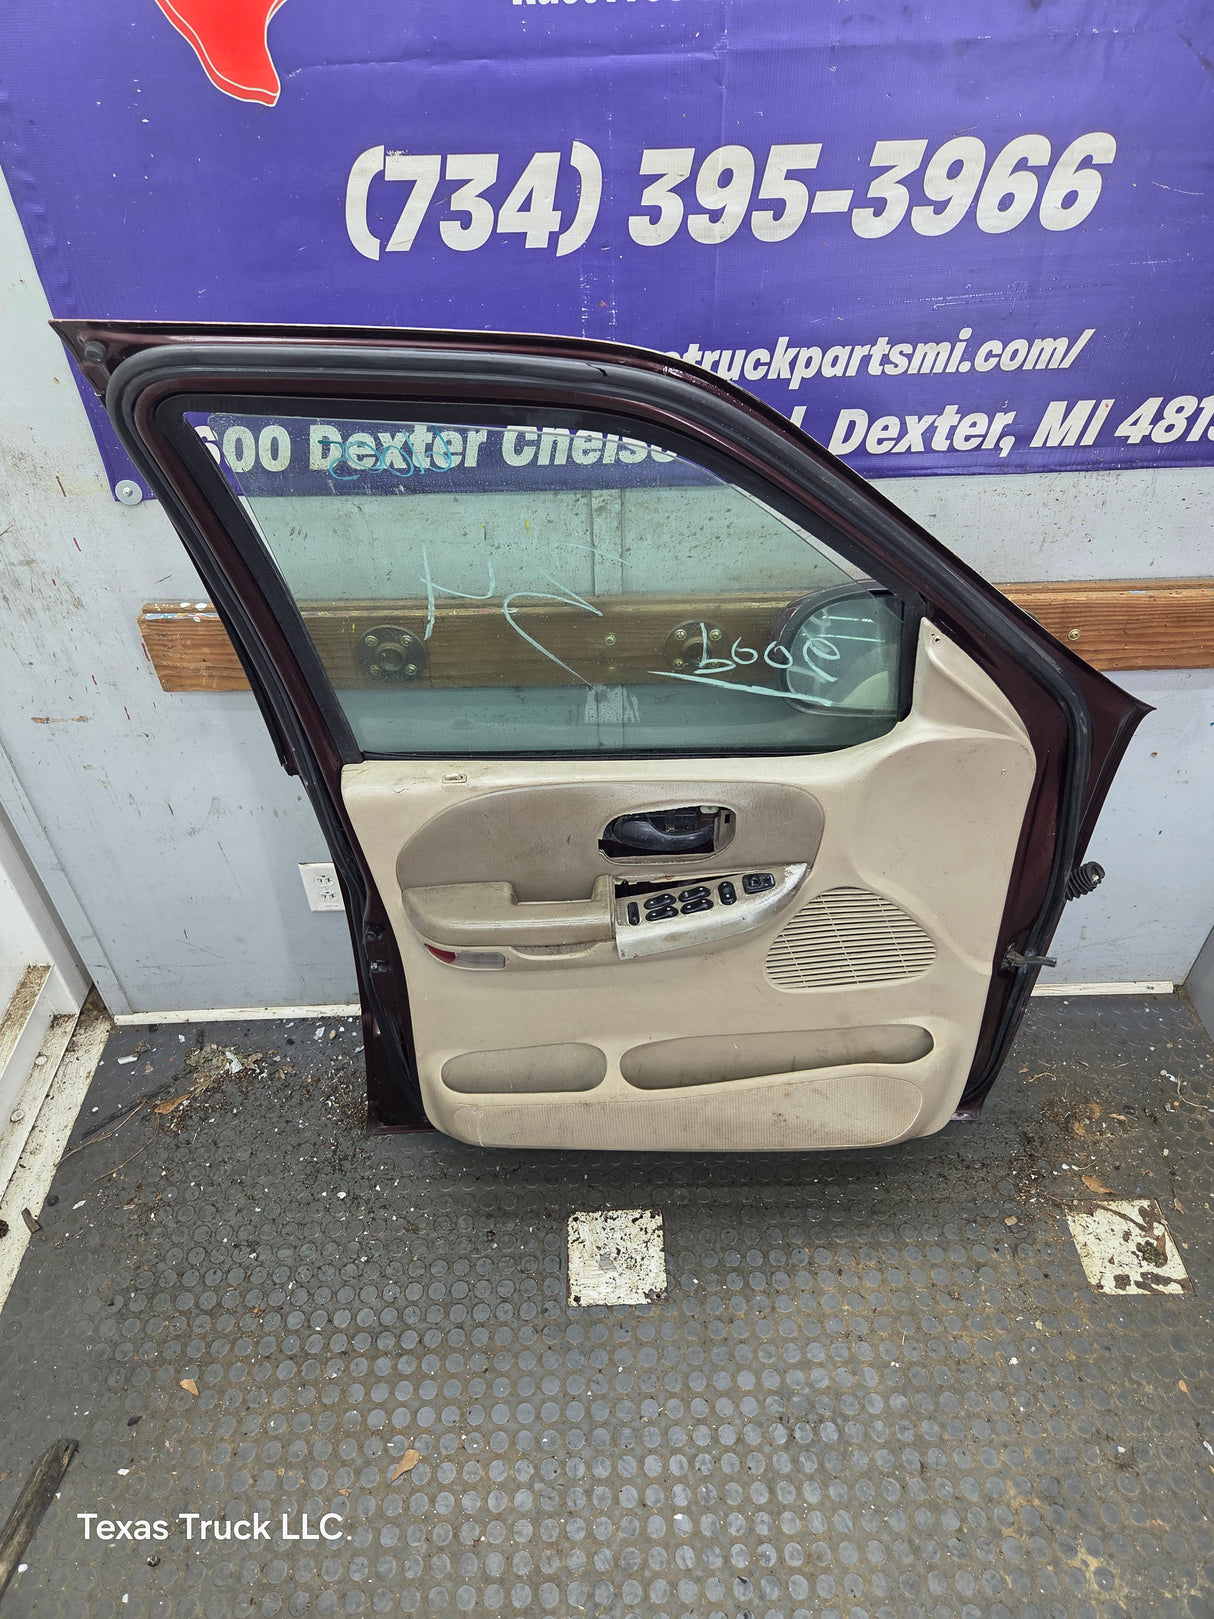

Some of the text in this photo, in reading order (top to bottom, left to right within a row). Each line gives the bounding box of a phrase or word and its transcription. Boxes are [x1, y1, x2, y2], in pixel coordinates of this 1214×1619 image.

[346, 132, 1117, 260] (734) 395-3966
[663, 328, 1096, 390] truckpartsmi.com/
[309, 424, 487, 472] Dexter
[828, 405, 1016, 457] Dexter,
[1030, 398, 1116, 448] MI
[1114, 395, 1214, 444] 481
